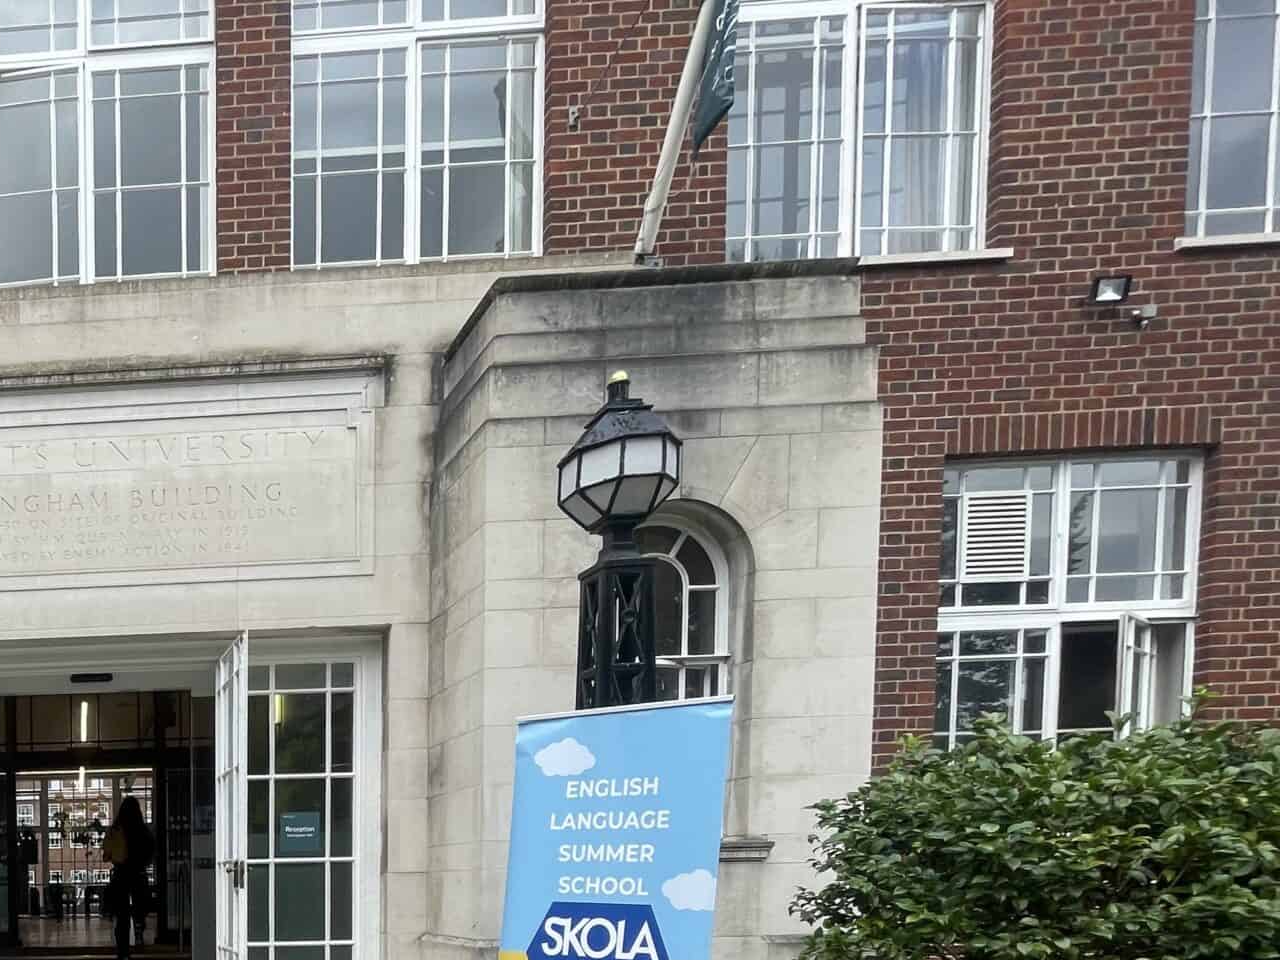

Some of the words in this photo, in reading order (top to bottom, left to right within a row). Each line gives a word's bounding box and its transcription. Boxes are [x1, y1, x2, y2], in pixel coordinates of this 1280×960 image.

[73, 429, 326, 468] UNIVERSITY
[129, 481, 282, 508] BUILDING
[565, 776, 659, 799] ENGLISH
[549, 810, 670, 831] LANGUAGE
[558, 843, 655, 863] SUMMER
[558, 876, 649, 896] SCHOOL
